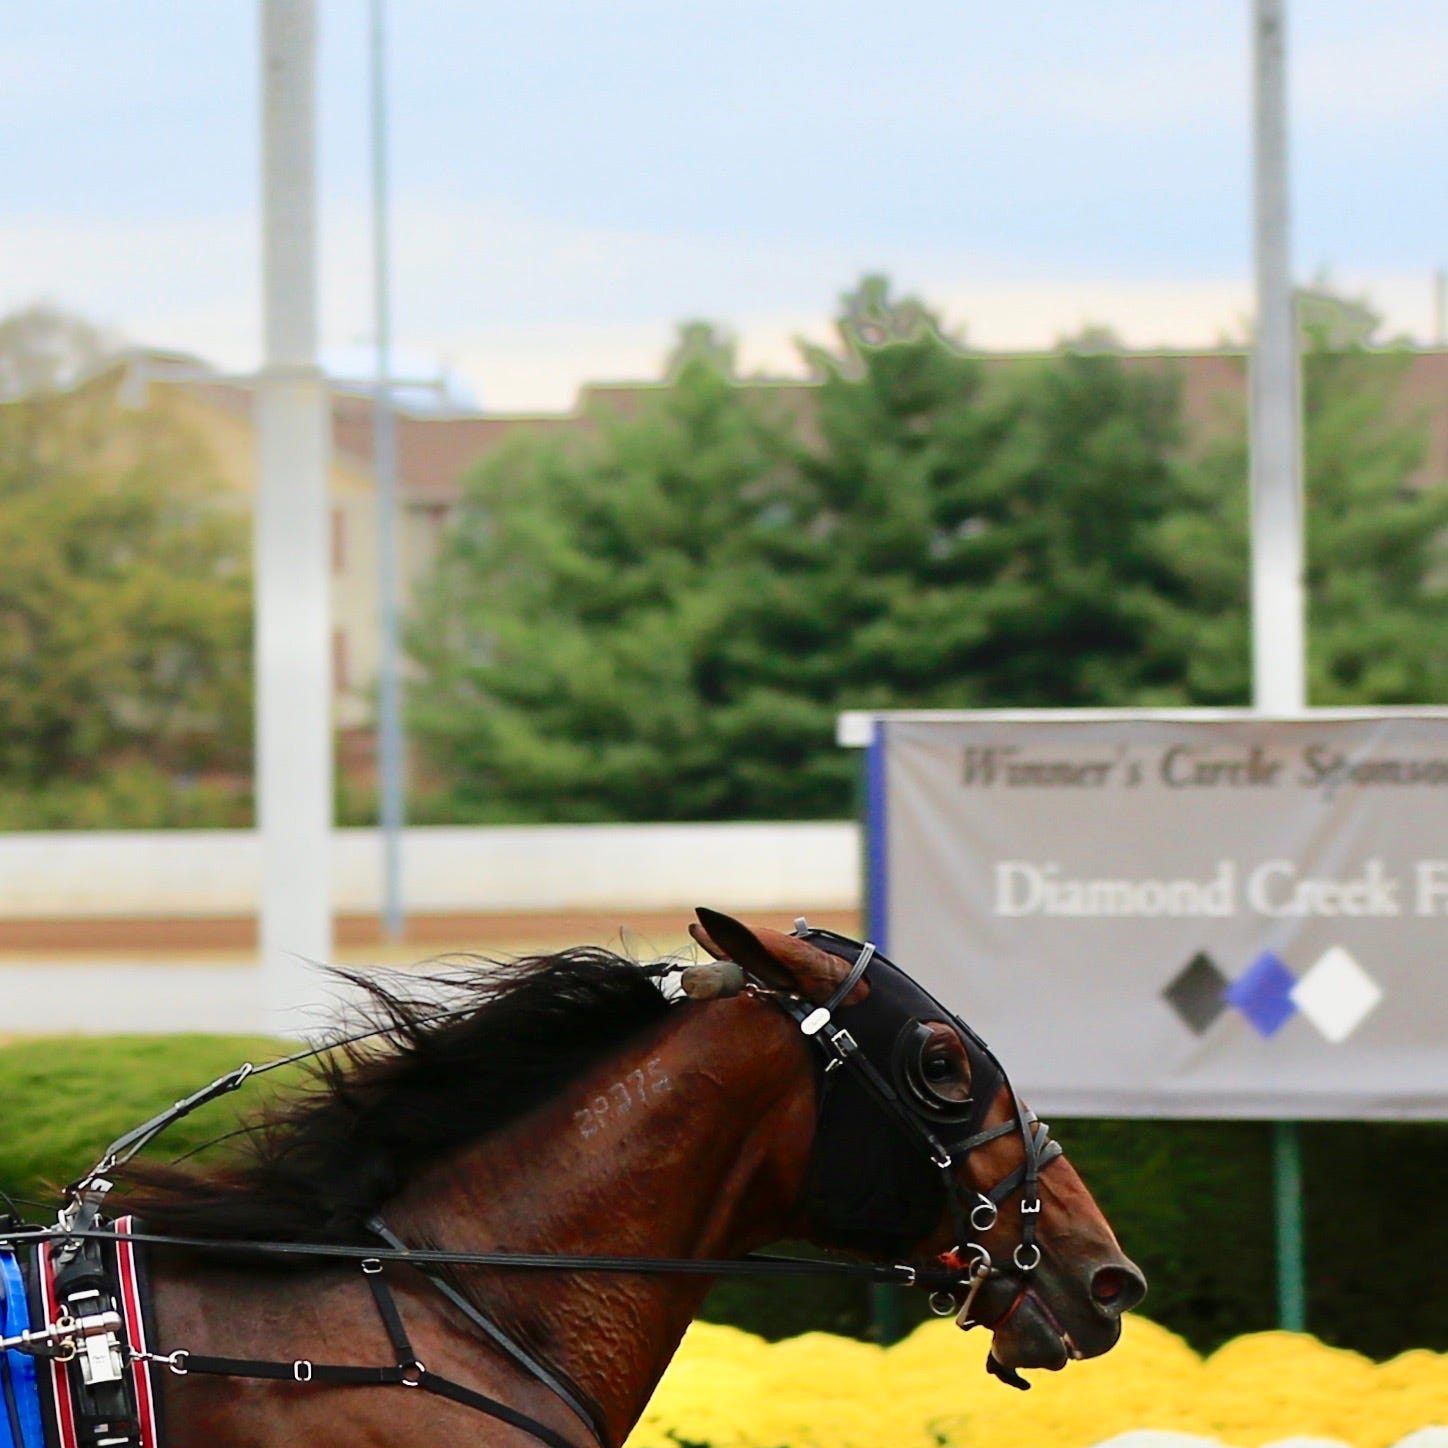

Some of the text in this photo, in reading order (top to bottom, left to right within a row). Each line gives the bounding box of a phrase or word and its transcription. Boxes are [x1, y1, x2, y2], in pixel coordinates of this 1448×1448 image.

[961, 743, 1143, 789] Winner's
[994, 857, 1237, 918] Diamond
[1246, 857, 1401, 919] Creek
